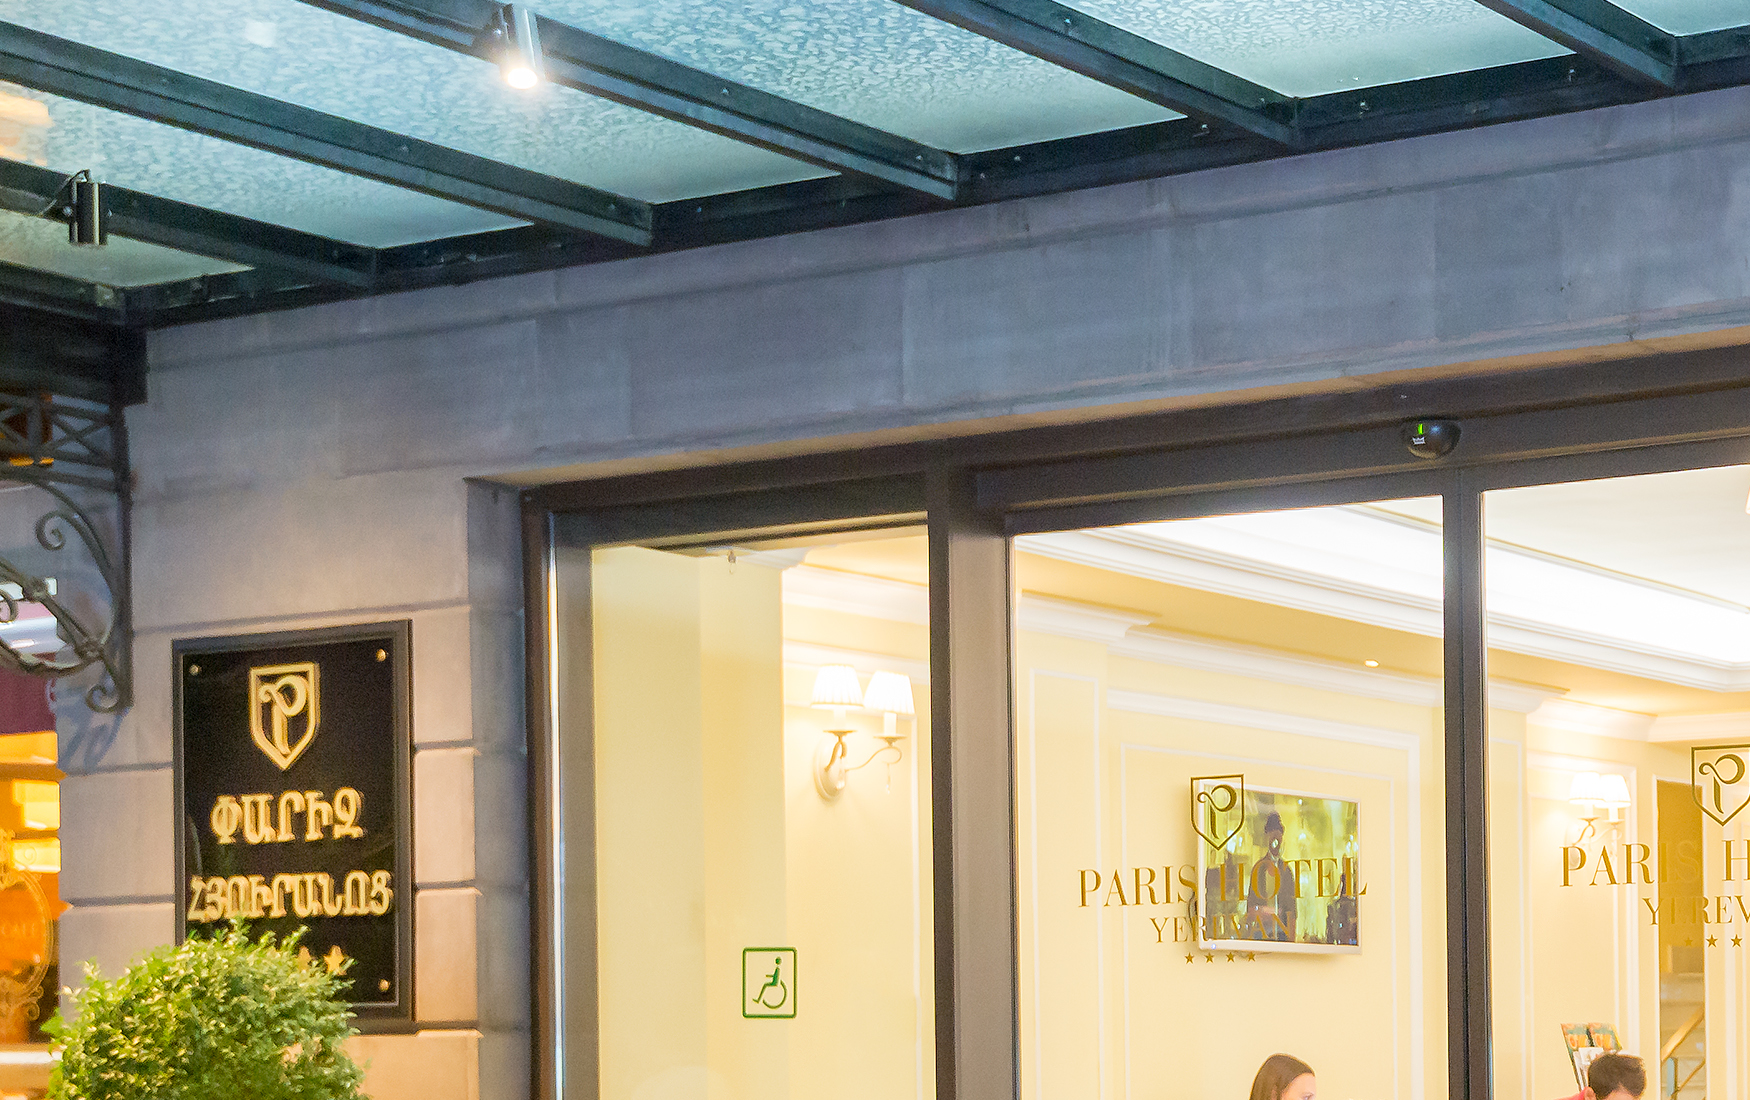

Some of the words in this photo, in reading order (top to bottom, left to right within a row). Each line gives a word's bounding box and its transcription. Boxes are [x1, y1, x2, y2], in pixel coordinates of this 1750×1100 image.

[1077, 864, 1197, 908] PARIS
[1218, 856, 1368, 903] HOTEL
[1559, 840, 1699, 888] PARIS
[1149, 910, 1294, 944] YEREVAN
